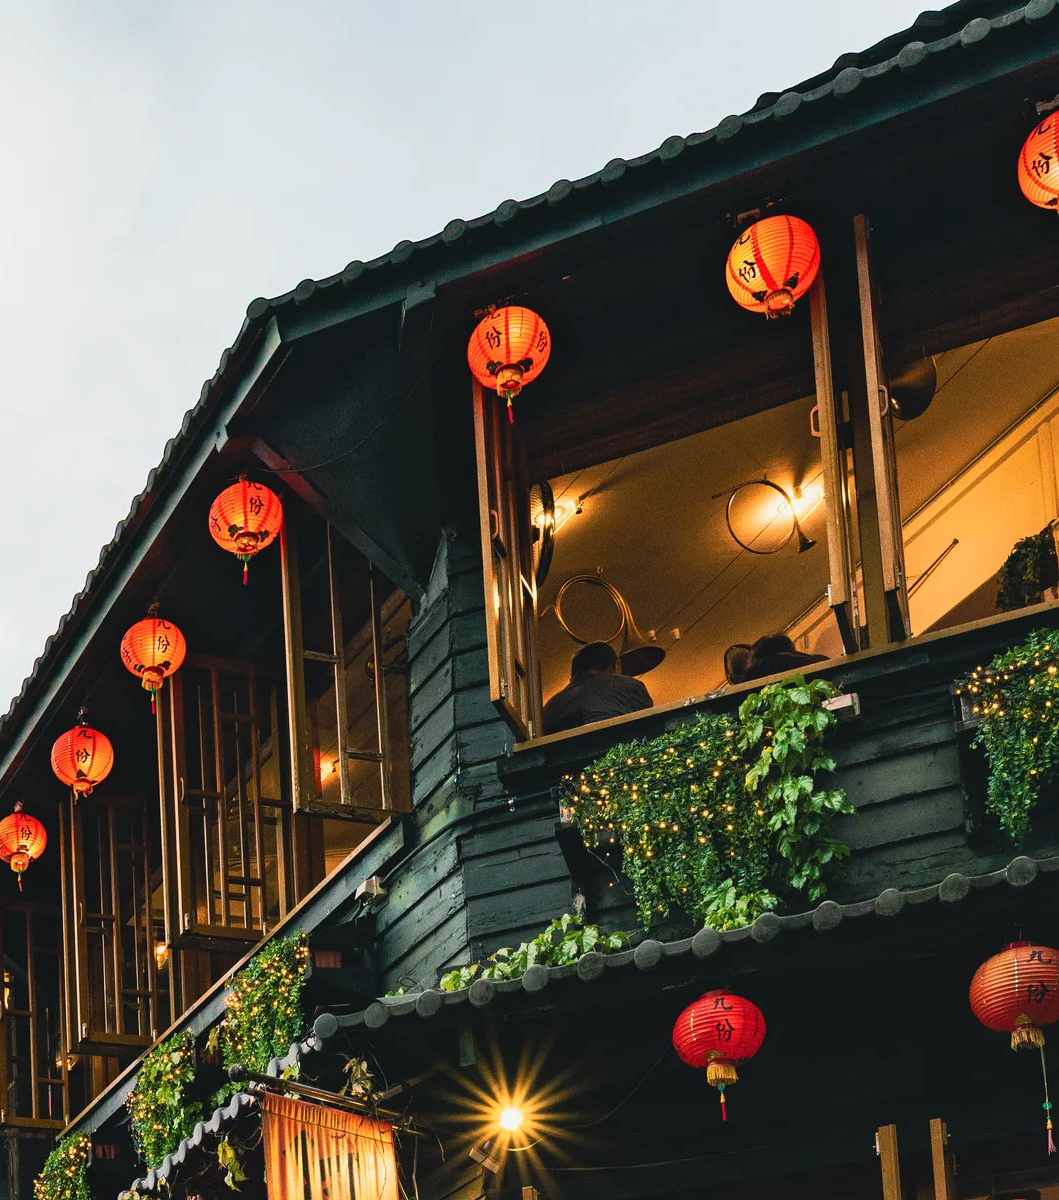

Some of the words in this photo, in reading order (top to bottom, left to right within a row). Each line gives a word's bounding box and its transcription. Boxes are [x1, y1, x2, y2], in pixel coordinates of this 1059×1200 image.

[157, 620, 171, 653] 九份
[75, 730, 91, 763] 九份
[1026, 950, 1053, 1003] 九份
[713, 998, 735, 1042] 九份
